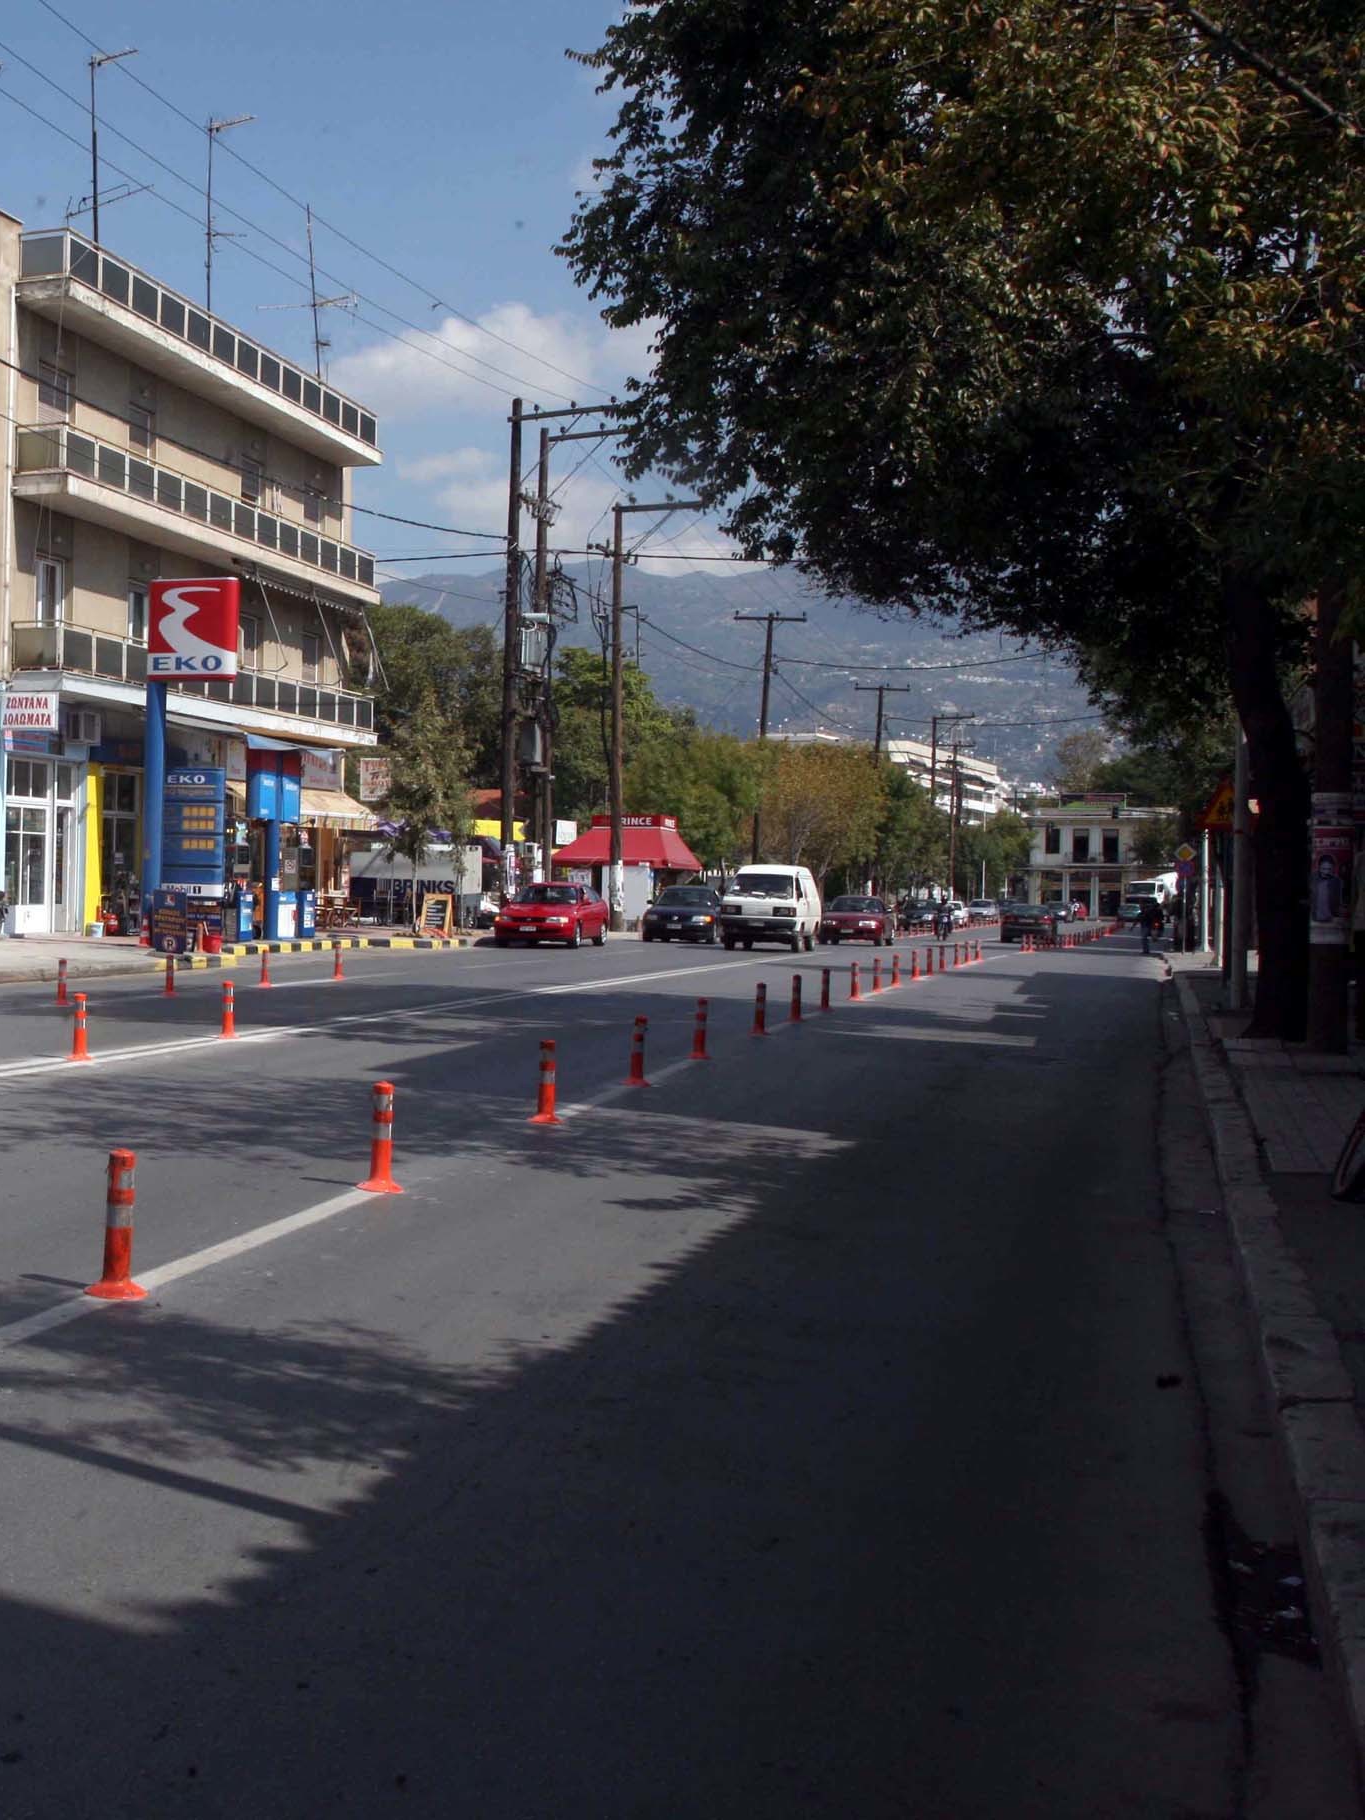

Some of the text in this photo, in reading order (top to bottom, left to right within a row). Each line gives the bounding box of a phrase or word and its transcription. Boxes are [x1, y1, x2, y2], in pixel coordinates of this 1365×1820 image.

[6, 696, 49, 710] ΖΩΝΤΑΝΑ
[2, 712, 52, 726] ΔΟΛΩΜΑΤΑ
[166, 774, 207, 784] EKO
[621, 816, 652, 826] RINCE
